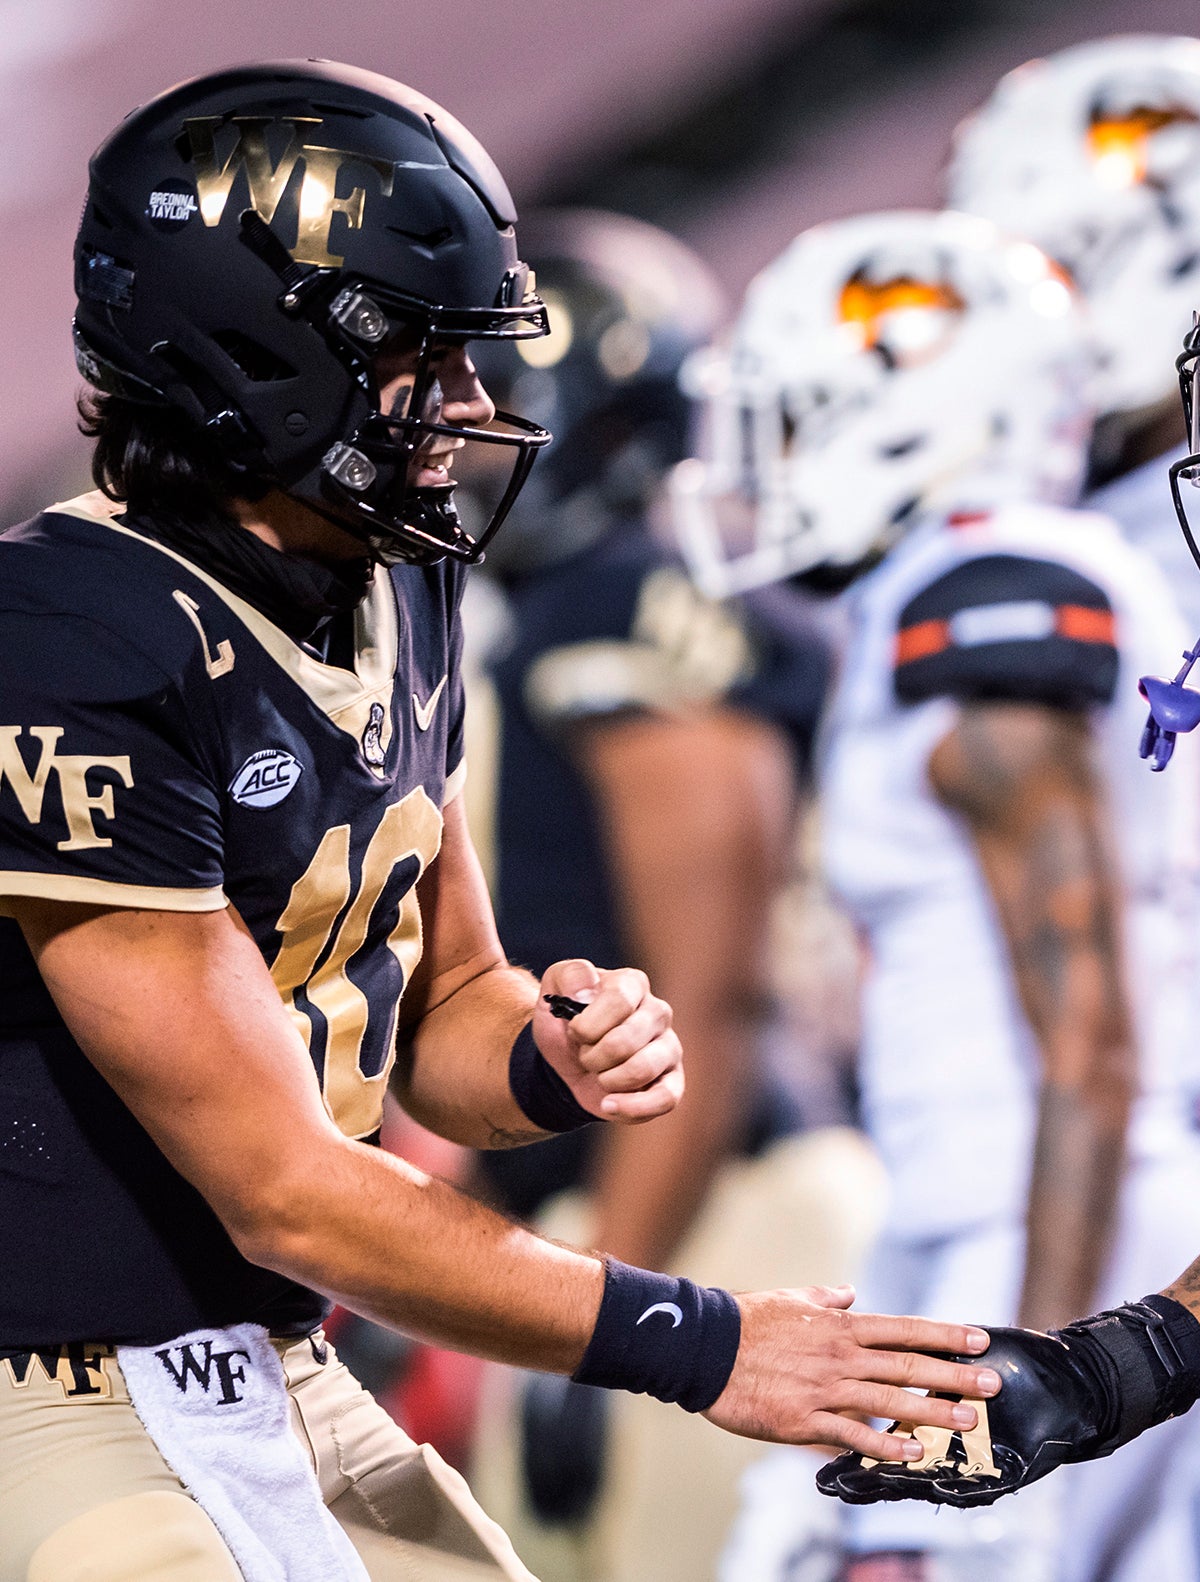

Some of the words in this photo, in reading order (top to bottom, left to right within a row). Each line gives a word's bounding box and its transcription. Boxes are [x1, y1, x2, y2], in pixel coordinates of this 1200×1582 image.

[149, 191, 194, 207] BREONNA
[151, 204, 190, 220] TAYLOR
[183, 115, 393, 267] WF
[240, 760, 291, 793] ACC
[270, 785, 445, 1139] 10
[155, 1340, 250, 1405] WF
